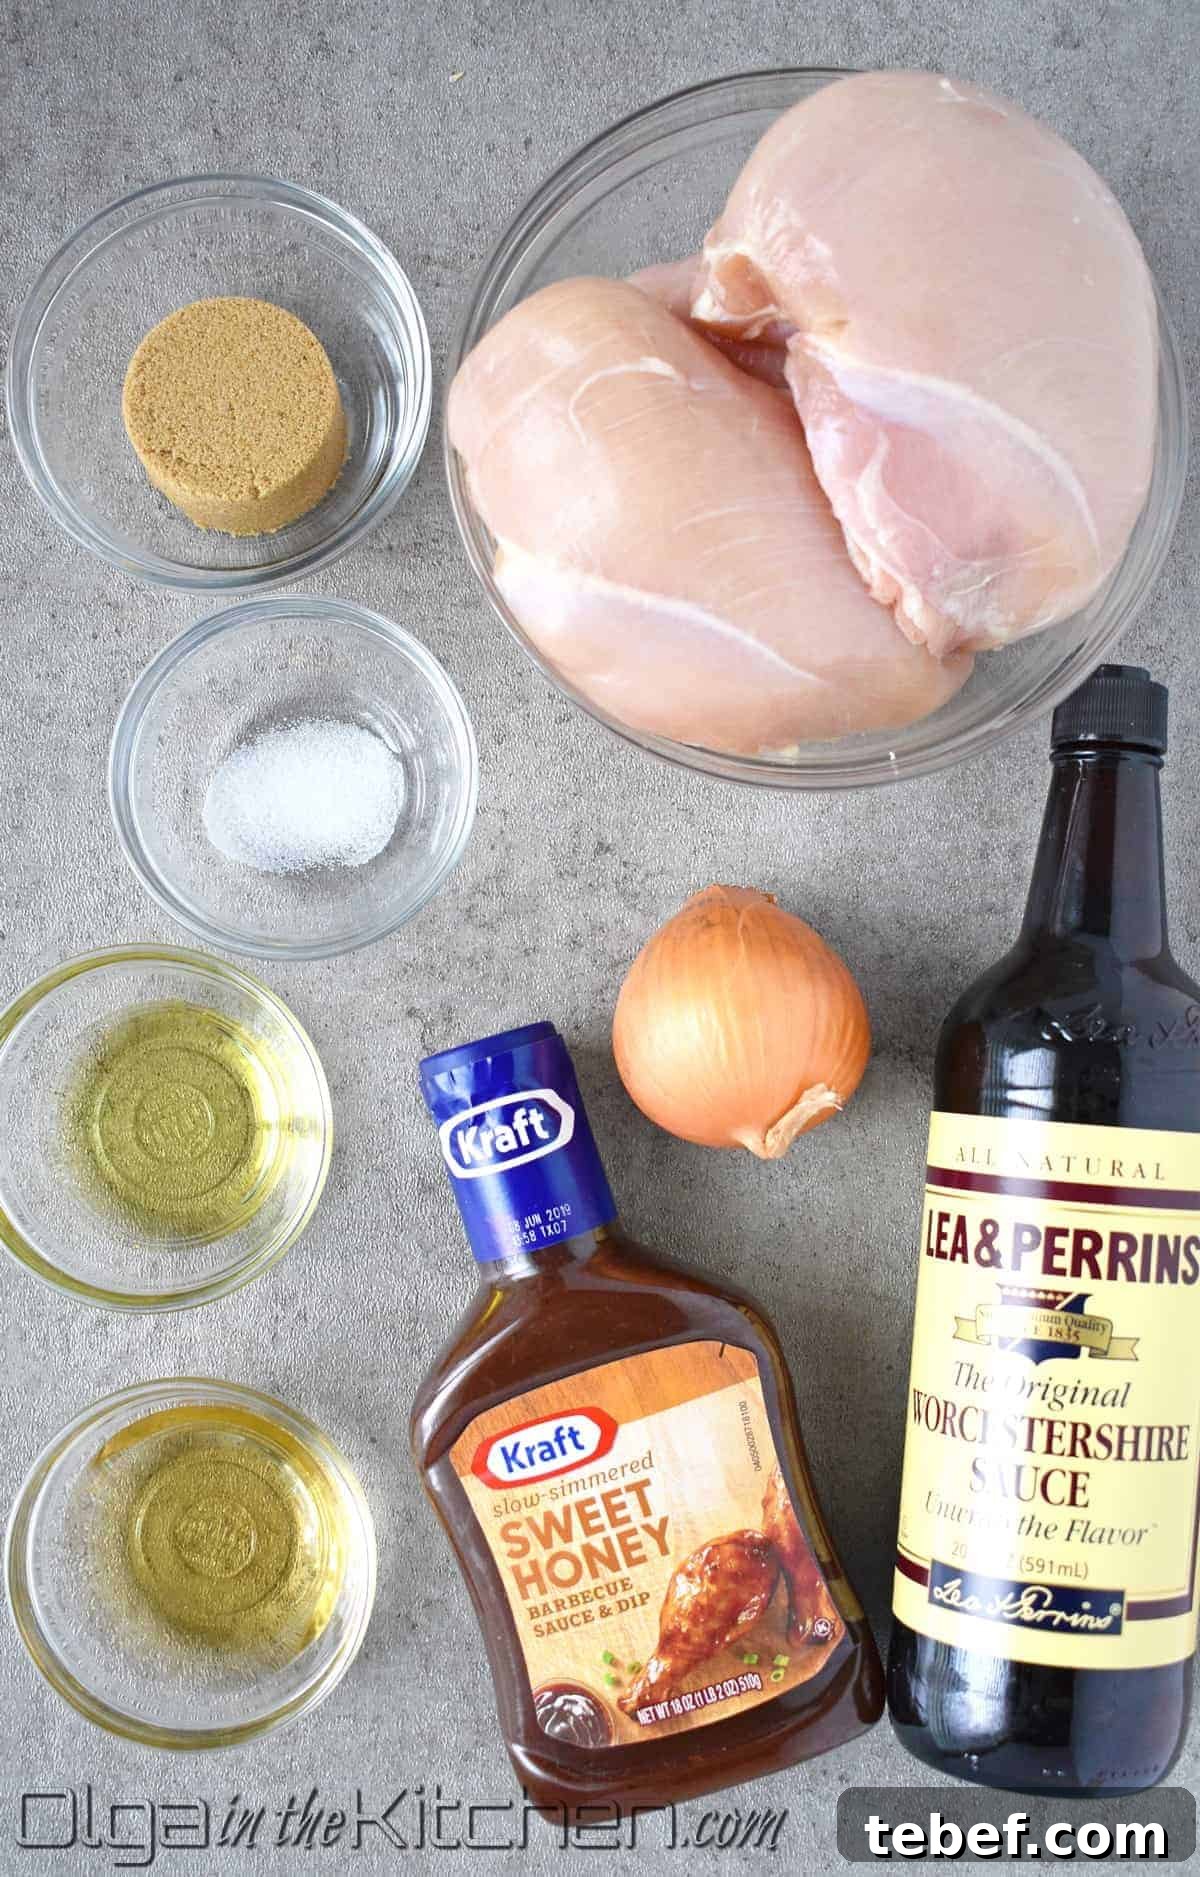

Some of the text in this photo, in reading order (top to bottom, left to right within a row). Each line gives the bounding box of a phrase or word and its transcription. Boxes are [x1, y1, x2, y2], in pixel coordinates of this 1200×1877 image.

[457, 1107, 550, 1164] Kraft
[955, 1146, 996, 1166] ALL
[524, 1213, 543, 1230] JUN
[545, 1203, 571, 1222] 2019
[1064, 1314, 1107, 1335] Quality
[953, 1360, 994, 1392] The
[500, 1425, 585, 1474] Kraft
[493, 1450, 655, 1518] slow-simmered
[500, 1478, 653, 1560] SWEET
[1016, 1514, 1059, 1541] the
[1064, 1518, 1149, 1547] Flavor
[511, 1516, 670, 1601] HONEY
[1018, 1556, 1089, 1581] (591mL)
[526, 1577, 634, 1621] BARBECUE
[534, 1592, 651, 1638] SAUCE & DIP
[637, 1673, 762, 1725] NET WT 18 OZ (1 LB 2 OZ) 510g
